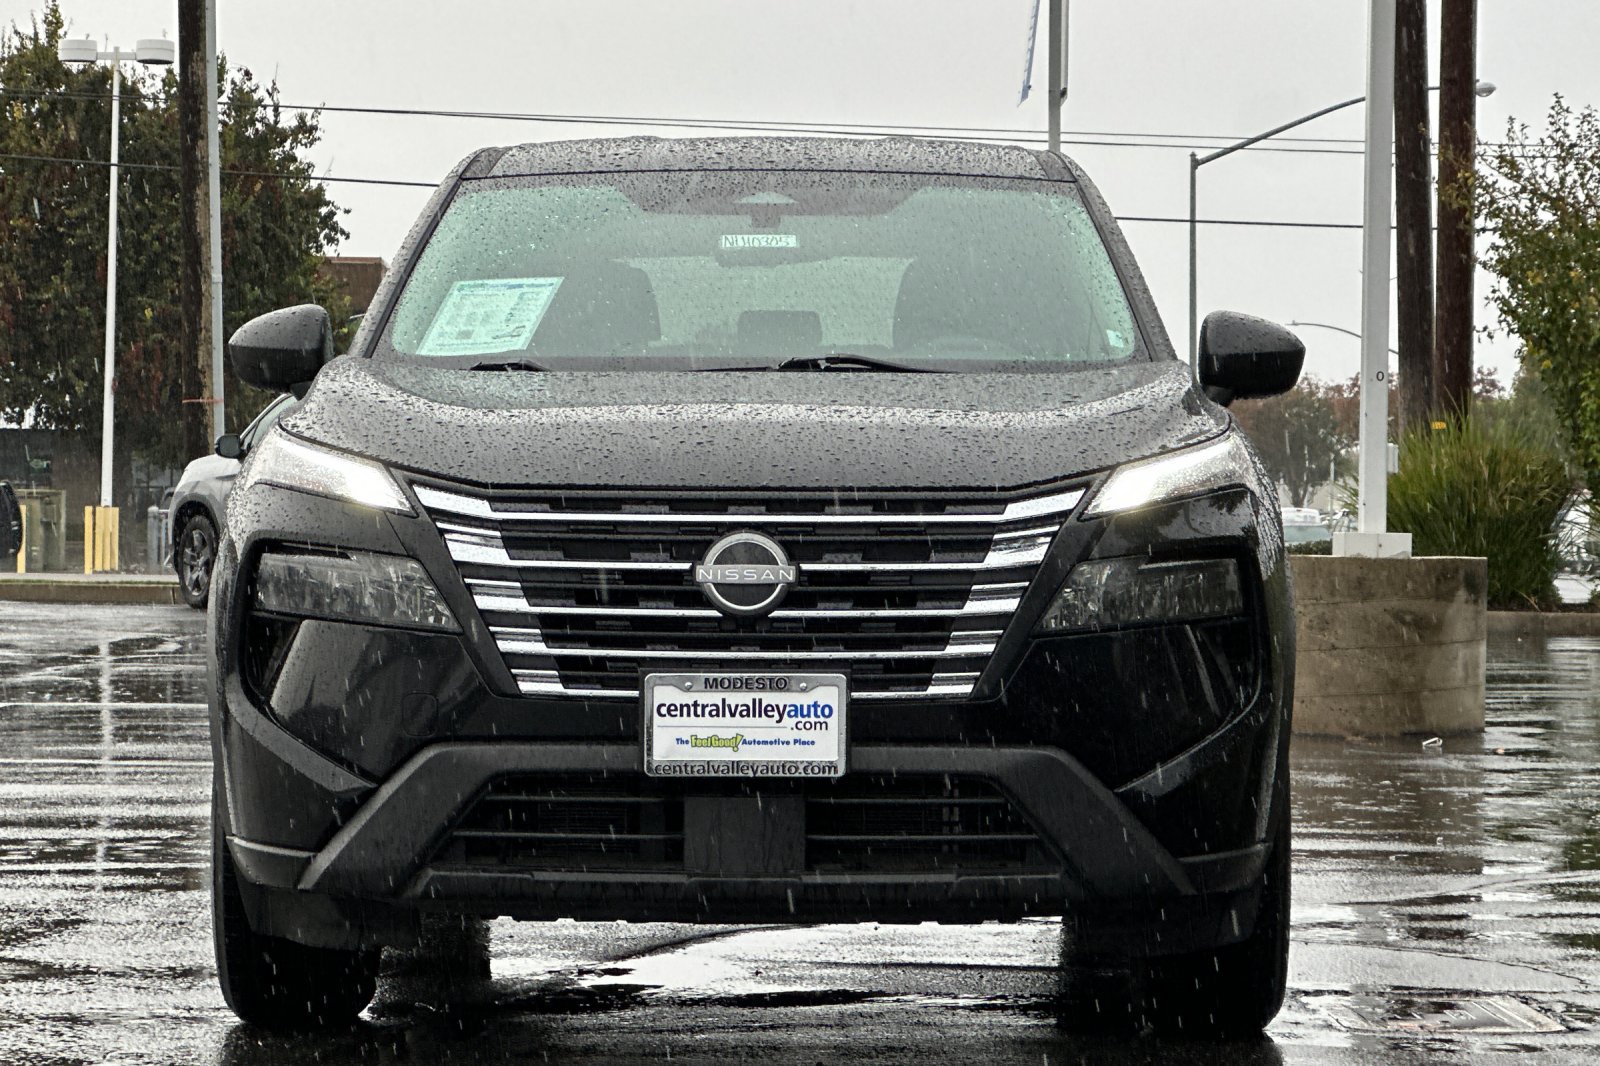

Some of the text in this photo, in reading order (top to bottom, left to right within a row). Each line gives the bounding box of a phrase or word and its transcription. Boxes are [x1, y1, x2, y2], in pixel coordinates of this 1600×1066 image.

[699, 569, 793, 581] NISSAN
[703, 677, 789, 690] MODESTO
[656, 697, 834, 723] centralvalleyauto
[790, 720, 829, 731] .com
[675, 737, 690, 746] The
[741, 738, 791, 746] Automotive
[793, 738, 816, 746] Place
[654, 761, 839, 776] centralvalleyauto.com
